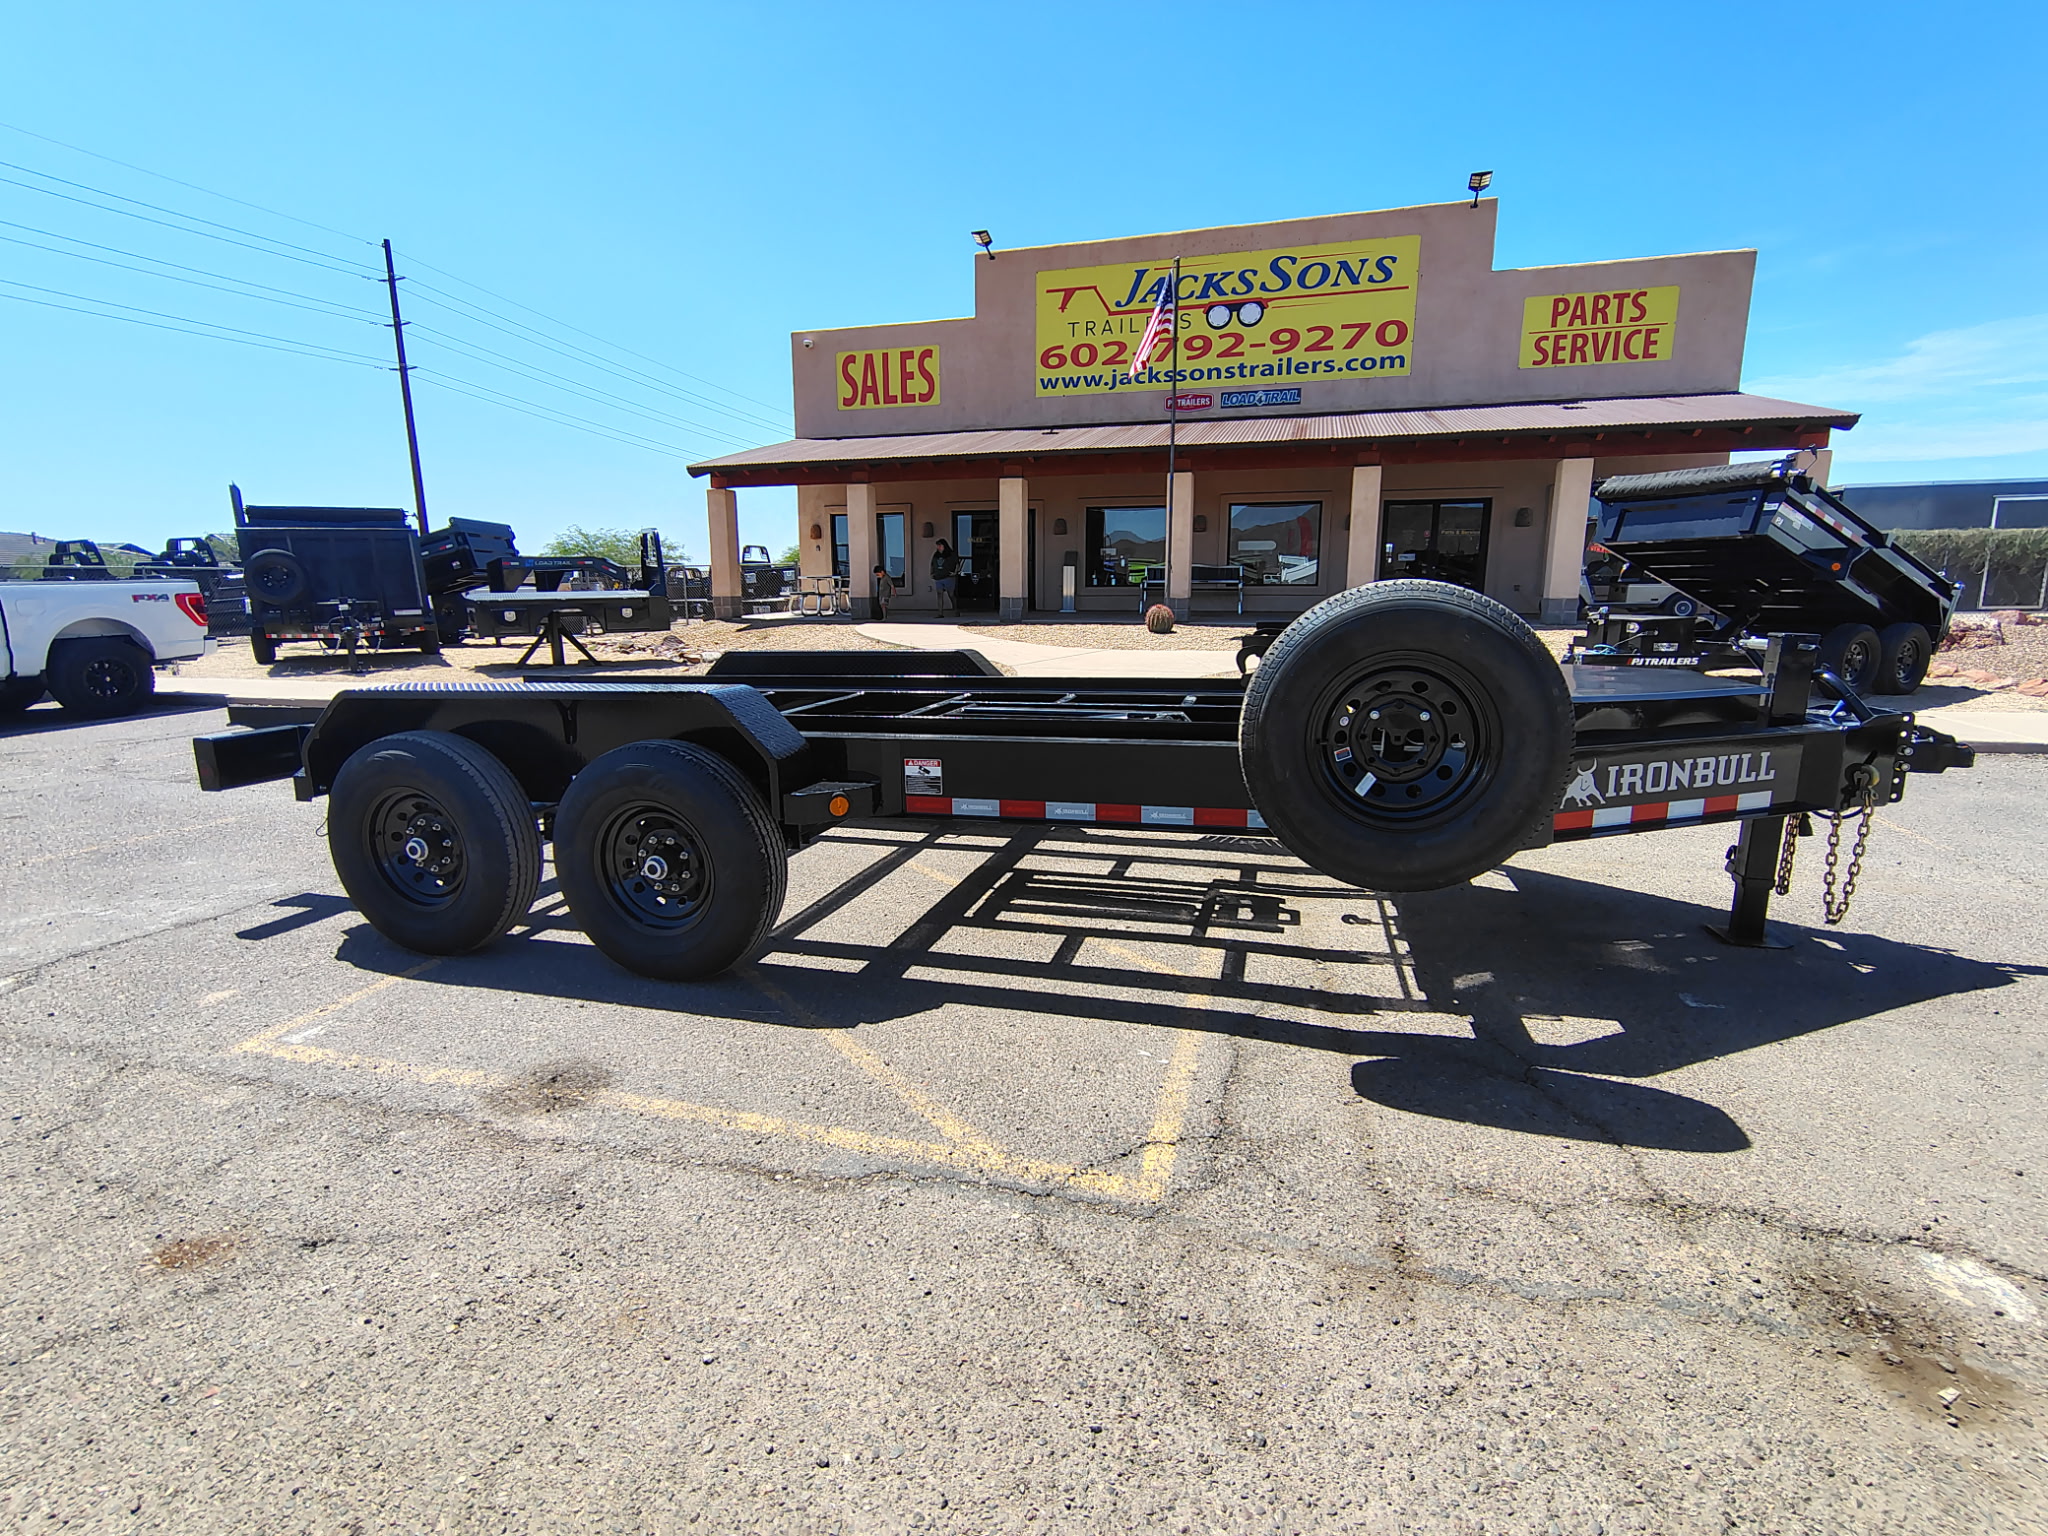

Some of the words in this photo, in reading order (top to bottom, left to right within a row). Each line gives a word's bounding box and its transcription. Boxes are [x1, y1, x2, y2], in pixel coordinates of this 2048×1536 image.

[1068, 313, 1192, 337] TRAILS
[1551, 290, 1648, 328] PARTS
[1532, 328, 1660, 365] SERVICE
[841, 348, 935, 407] SALES
[1040, 354, 1406, 390] www.jackssonstrailers.com
[1177, 397, 1210, 407] TRAILERS
[1222, 392, 1257, 406] LOAD
[1262, 390, 1301, 404] TRAIL
[1644, 657, 1699, 666] TRAILERS
[1606, 752, 1776, 797] IRONBULL
